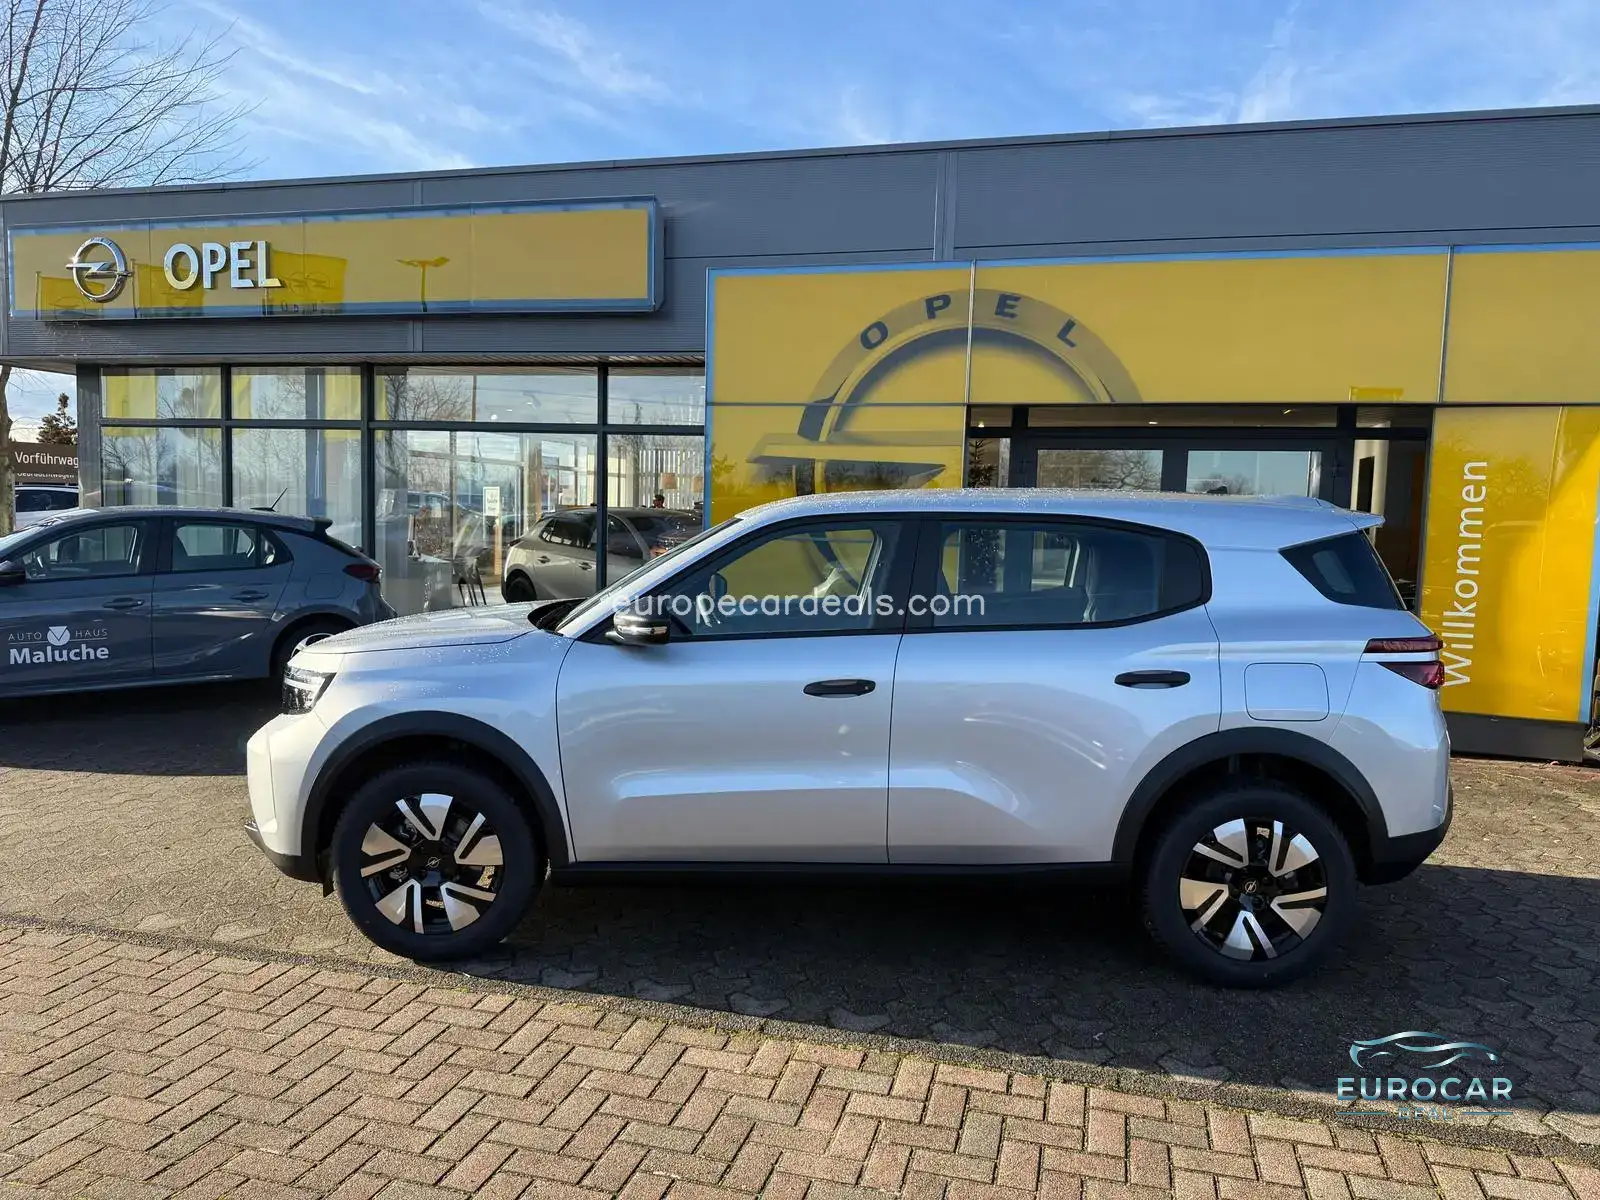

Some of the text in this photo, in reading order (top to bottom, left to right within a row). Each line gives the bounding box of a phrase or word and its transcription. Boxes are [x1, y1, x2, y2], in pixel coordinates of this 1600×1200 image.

[163, 239, 281, 290] OPEL
[859, 292, 1077, 351] OPEL
[1441, 460, 1488, 688] Willkommen
[8, 628, 108, 641] AUTO HAUS
[9, 643, 110, 665] Maluche
